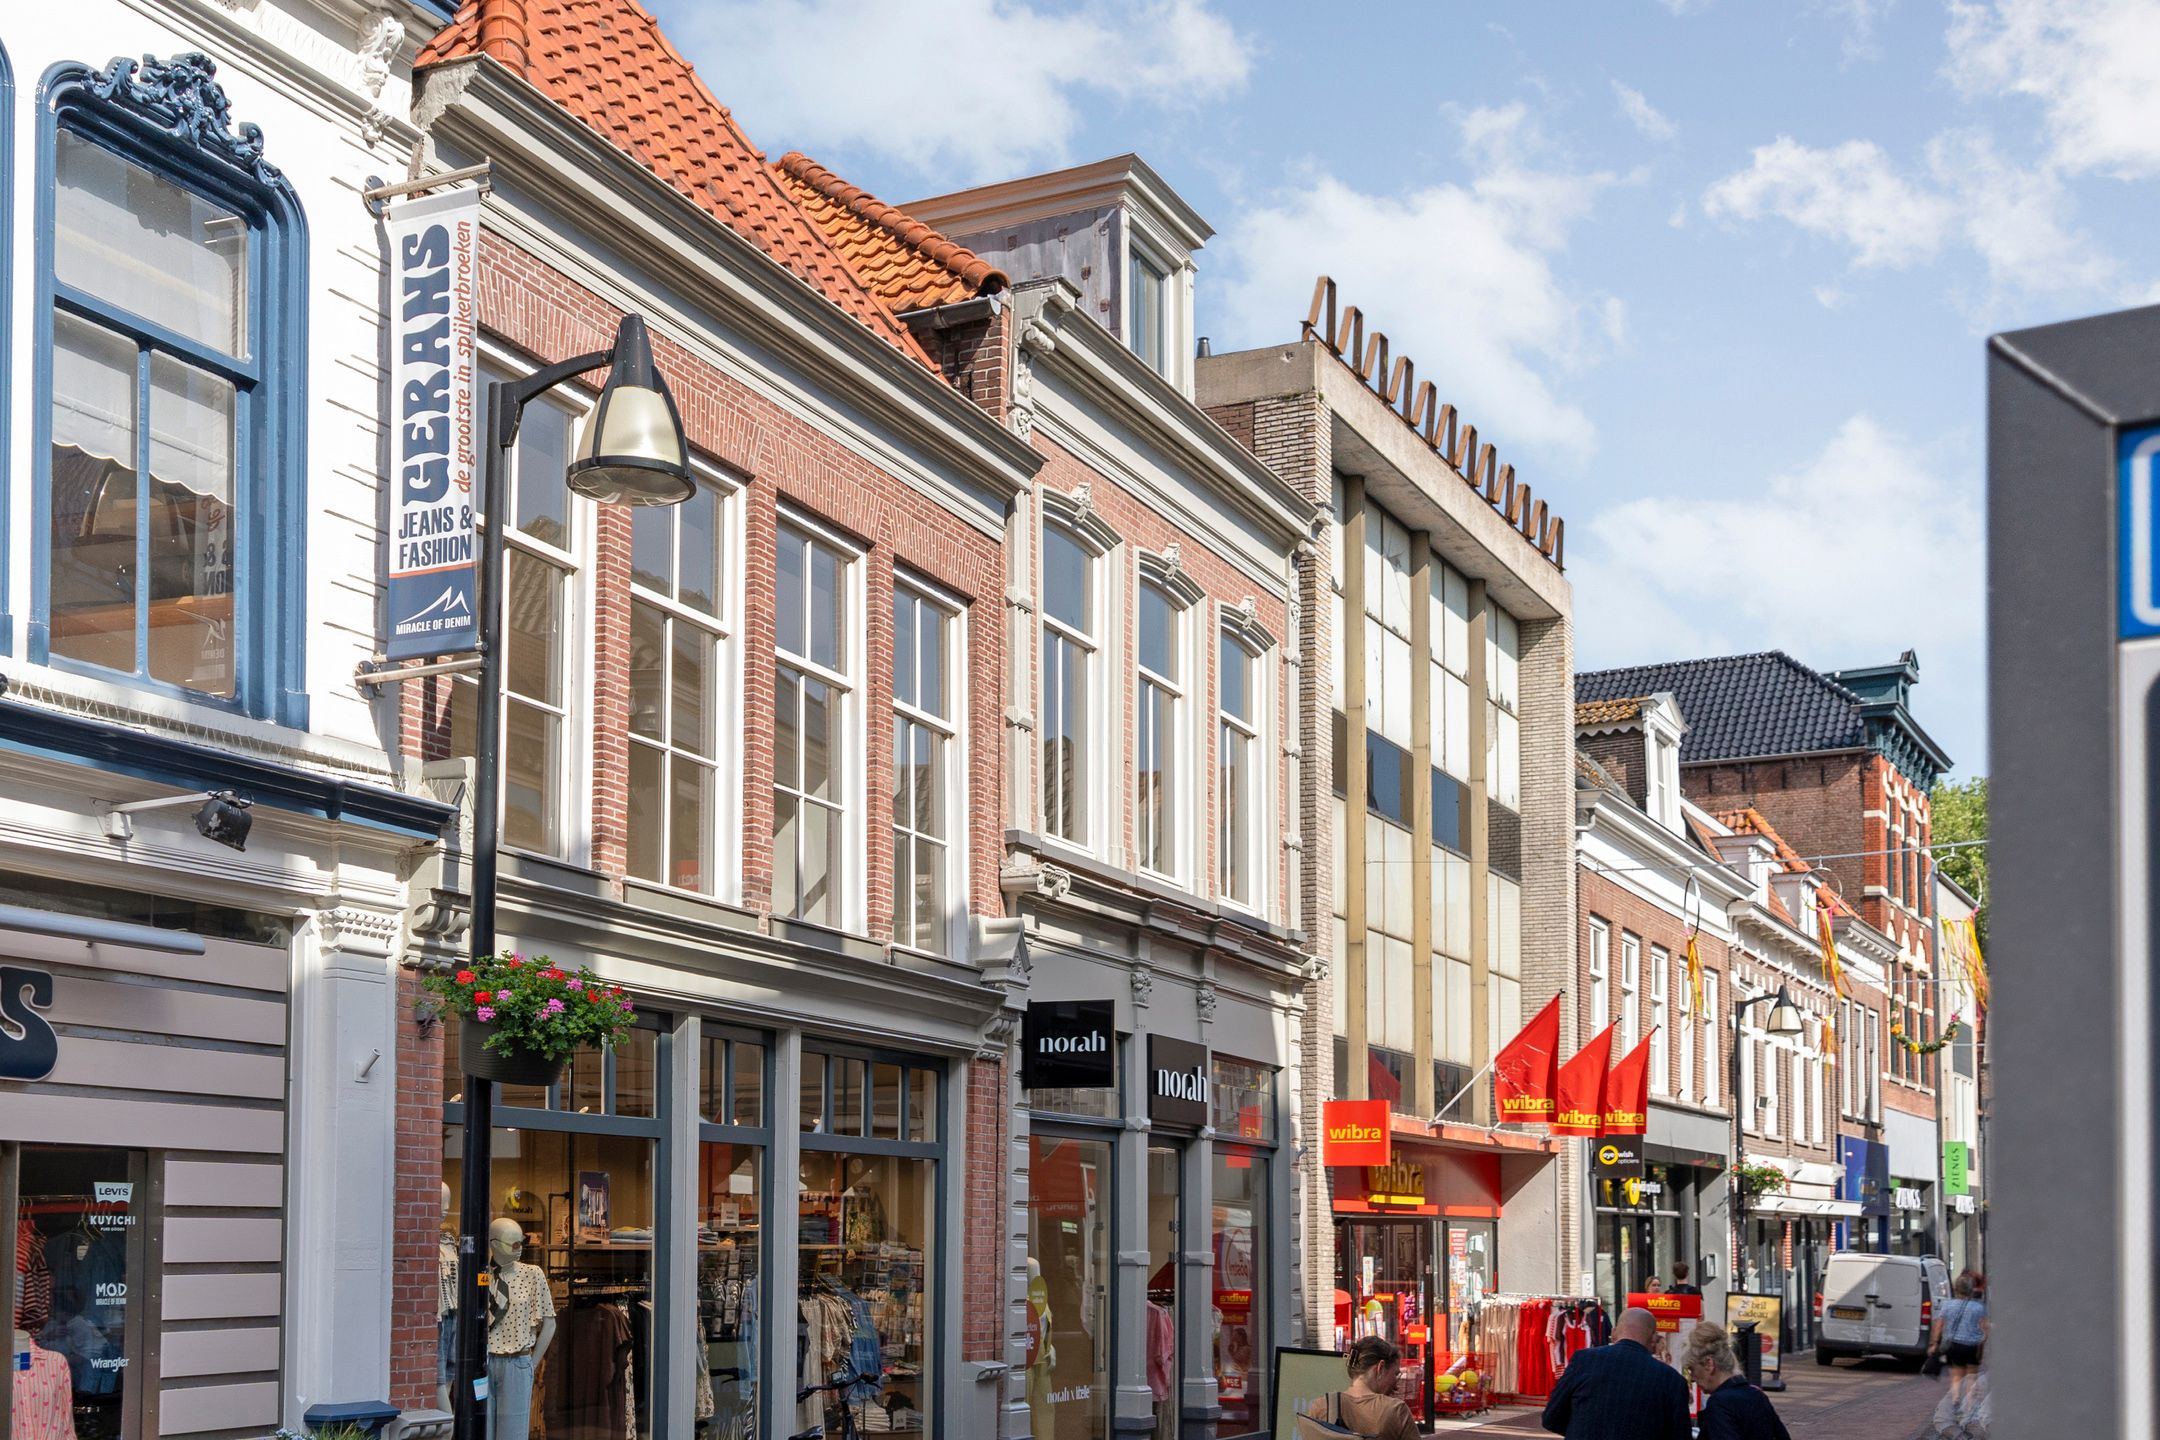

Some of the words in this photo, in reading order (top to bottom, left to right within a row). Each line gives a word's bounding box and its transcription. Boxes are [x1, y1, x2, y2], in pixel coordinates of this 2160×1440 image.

[452, 220, 476, 358] spijkerbroeken
[402, 224, 450, 506] GERANS
[453, 366, 471, 384] in
[456, 388, 475, 467] grootste
[453, 470, 471, 493] de
[399, 506, 454, 540] JEANS
[460, 504, 472, 529] &
[399, 533, 472, 570] FASHION
[396, 621, 432, 635] MIRACLE
[432, 619, 444, 630] OF
[444, 615, 471, 629] DENIM
[1039, 1030, 1106, 1053] norah
[1158, 1066, 1208, 1102] norah
[1502, 1094, 1555, 1110] wibra
[1329, 1124, 1382, 1139] wibra
[1951, 1147, 1960, 1188] ZIENGS
[90, 1215, 136, 1225] KUYICHI
[1647, 1297, 1681, 1308] wibra
[90, 1357, 130, 1373] Wrangler
